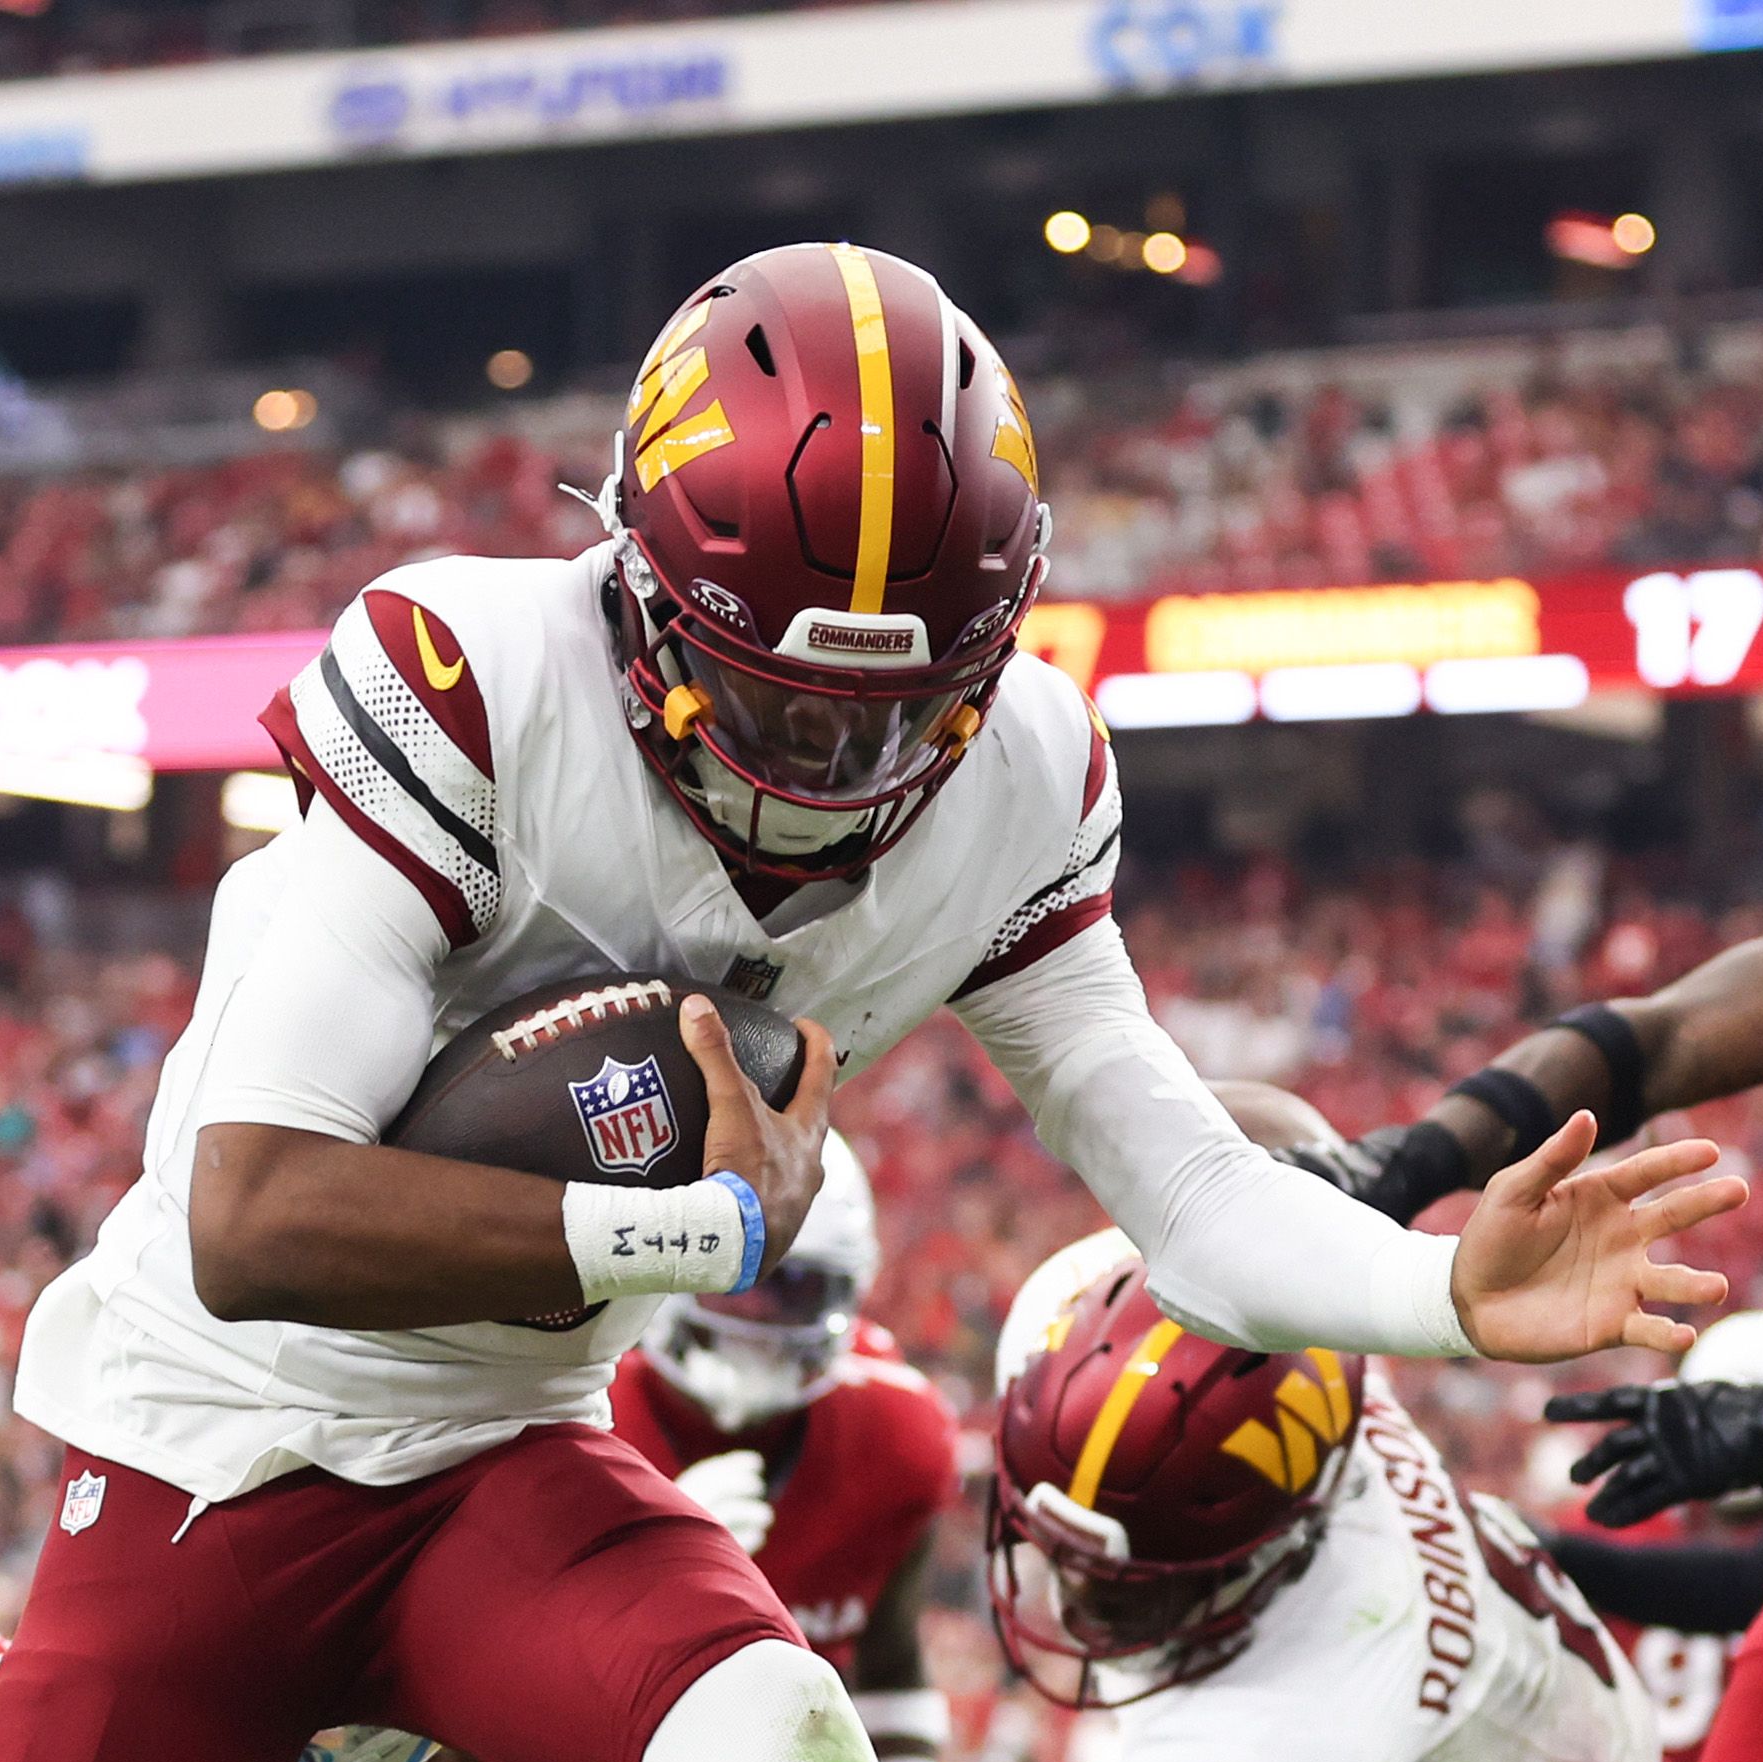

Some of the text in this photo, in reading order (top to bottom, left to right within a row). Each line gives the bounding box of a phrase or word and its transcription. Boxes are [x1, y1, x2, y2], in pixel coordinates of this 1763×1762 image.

[691, 589, 747, 628] OAKLEY
[807, 626, 914, 651] COMMANDERS
[594, 1101, 672, 1161] NFL
[66, 1498, 92, 1524] NFL
